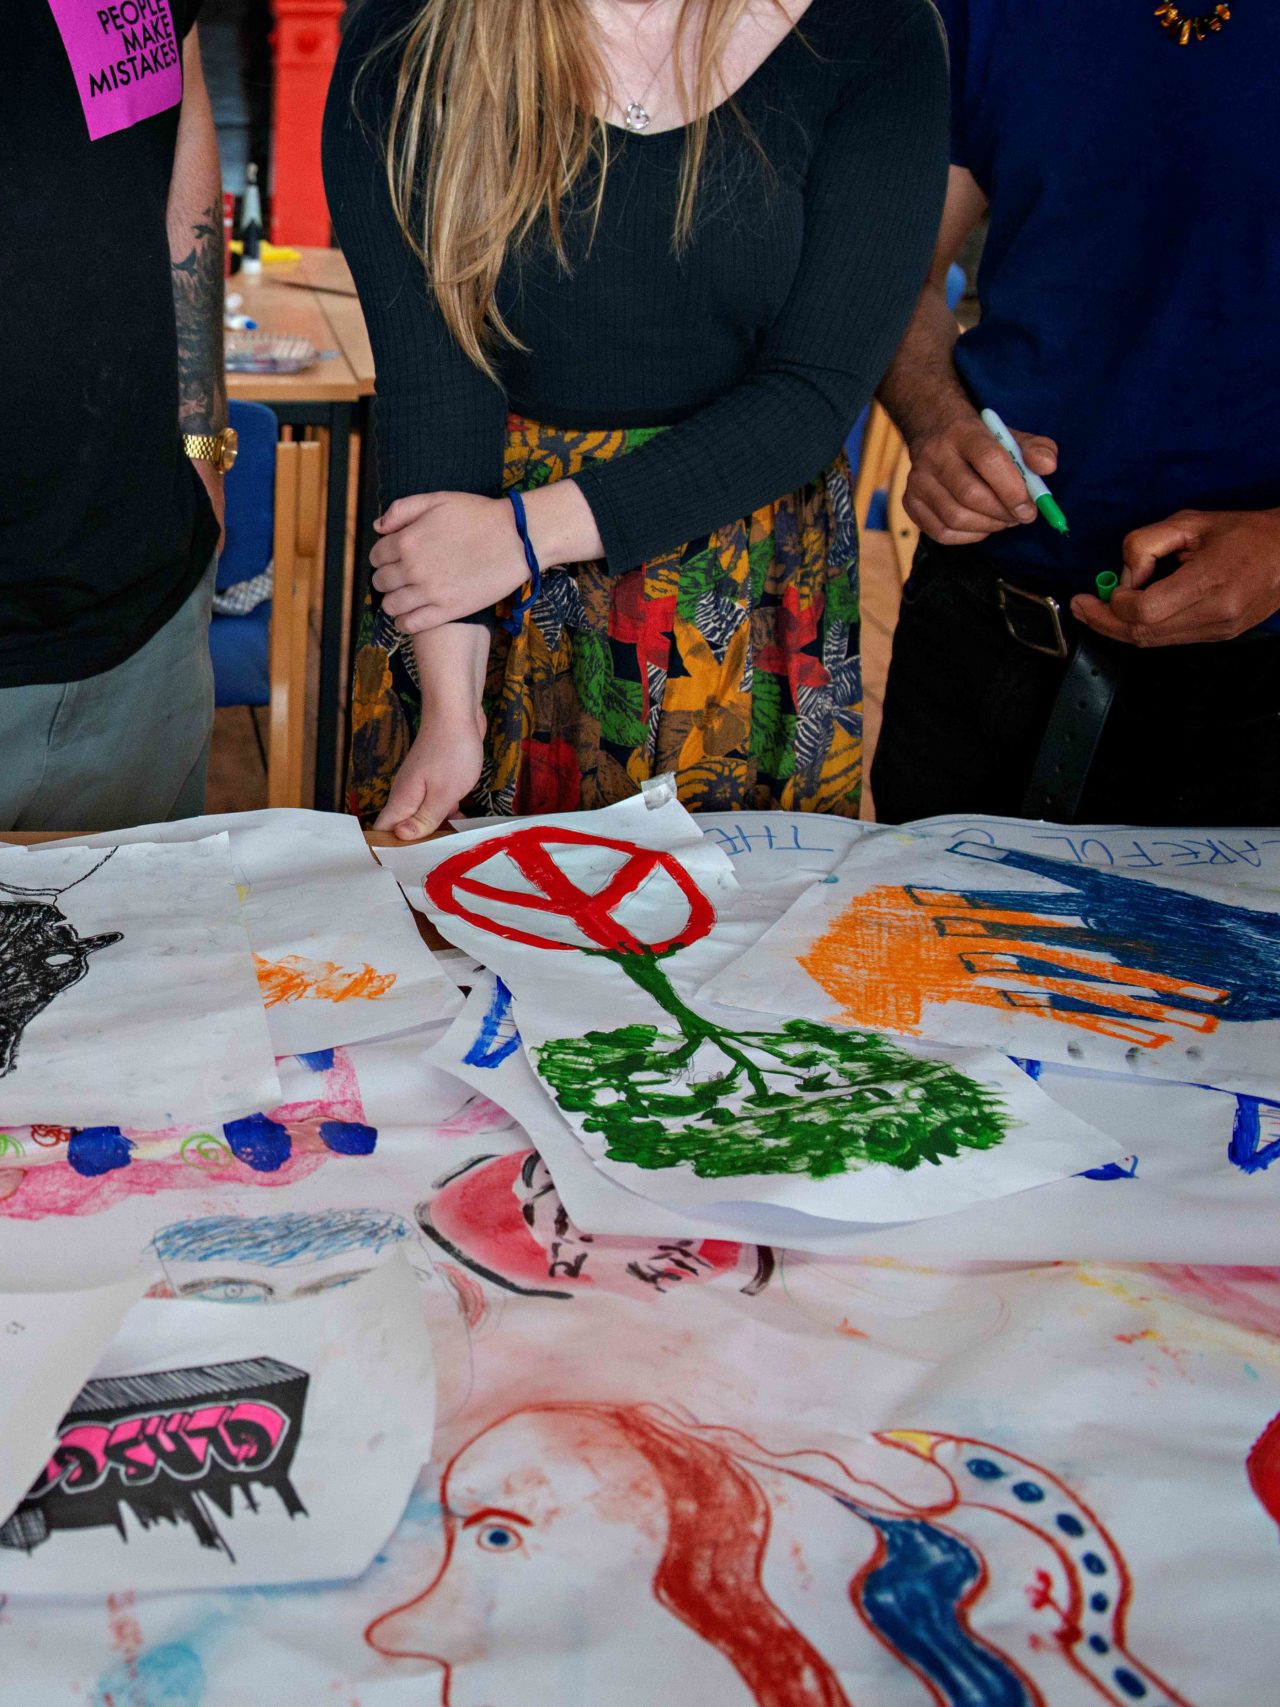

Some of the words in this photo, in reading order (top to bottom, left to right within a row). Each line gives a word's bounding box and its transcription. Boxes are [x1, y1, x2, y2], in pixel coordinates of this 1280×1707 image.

[96, 0, 166, 34] PEOPLE
[121, 13, 172, 55] MAKE
[88, 40, 177, 97] MISTAKES
[703, 825, 834, 857] THE
[1031, 836, 1280, 868] AREFUL
